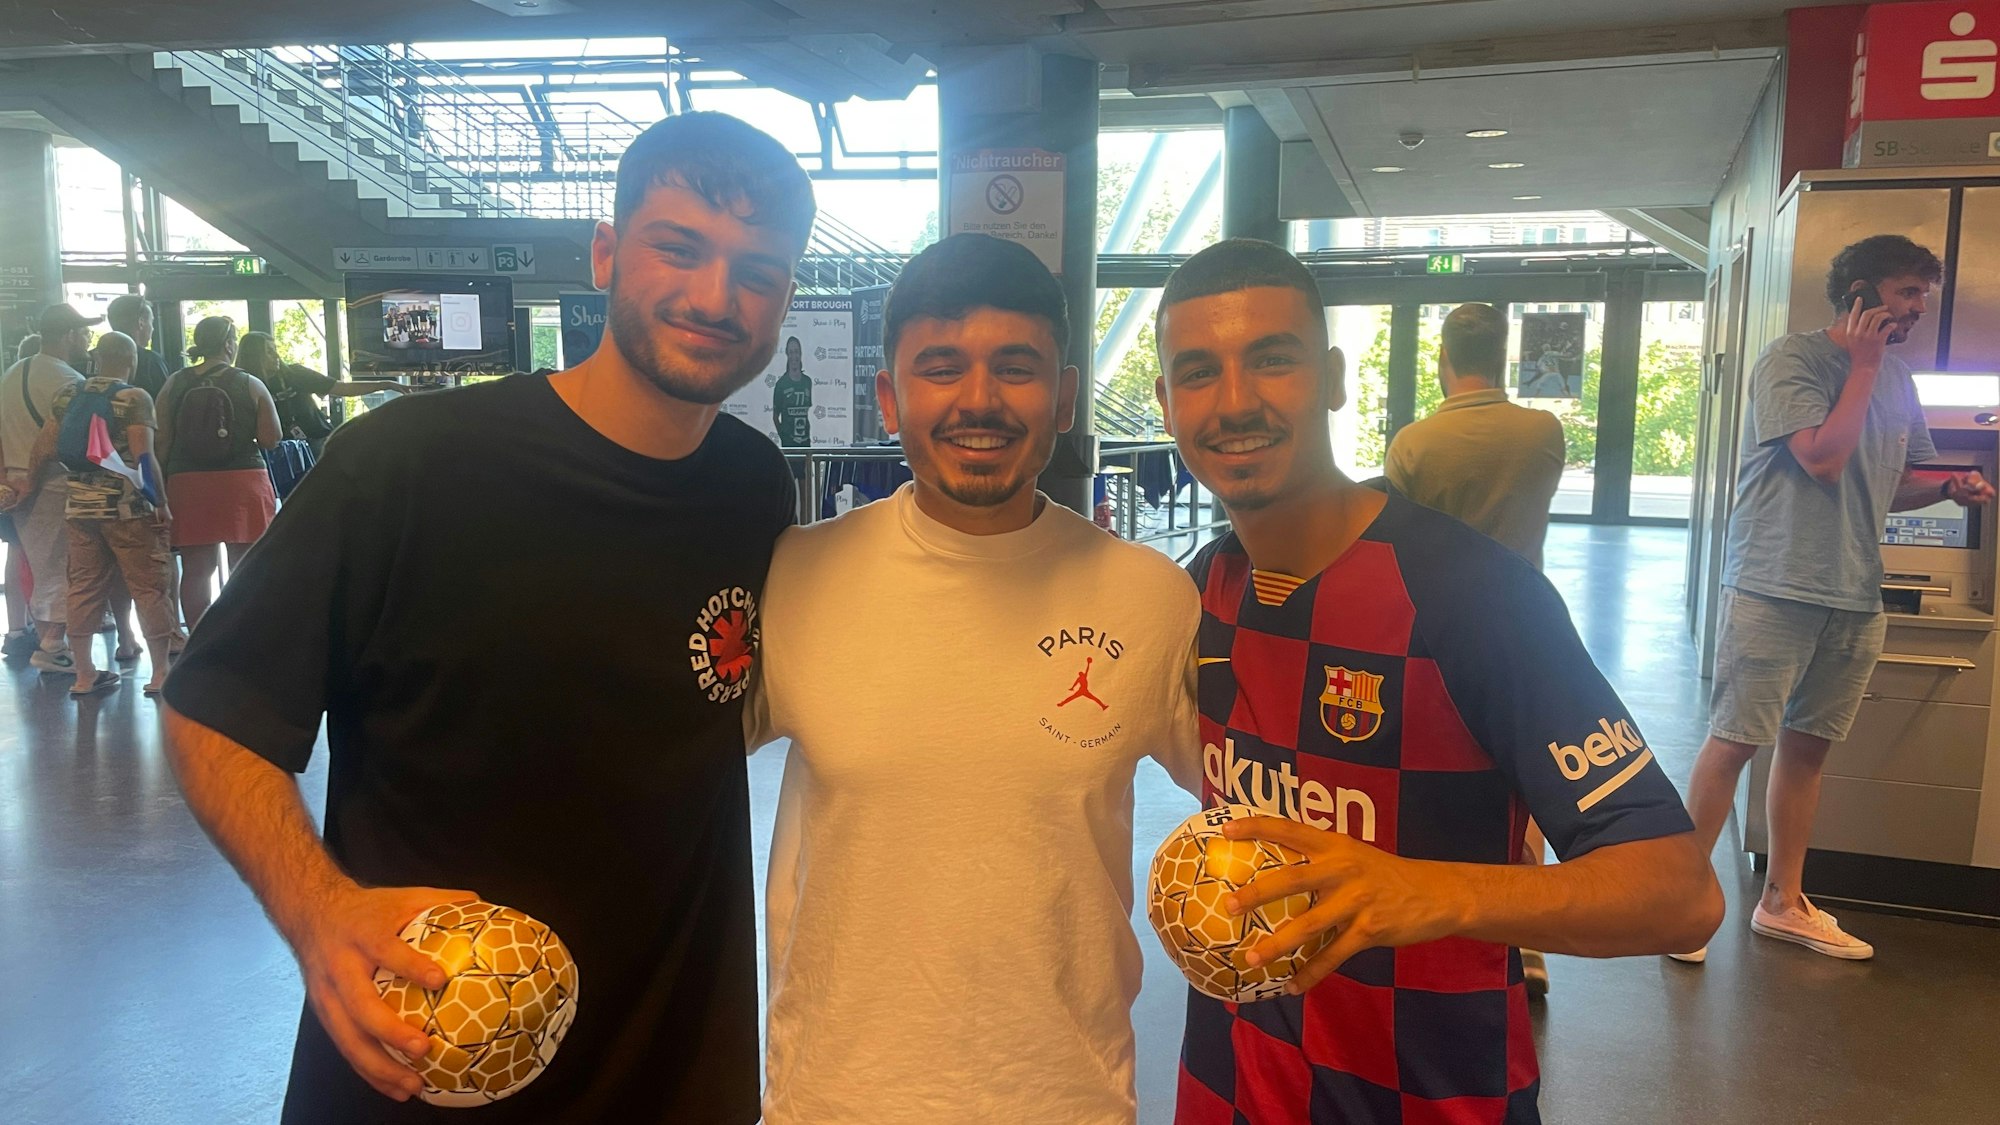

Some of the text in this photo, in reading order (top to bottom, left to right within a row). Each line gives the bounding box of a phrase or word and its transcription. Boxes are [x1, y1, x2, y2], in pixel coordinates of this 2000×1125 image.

[955, 153, 1060, 169] Nichtraucher
[963, 221, 1046, 231] Bitte nutzen Sie den
[498, 256, 514, 268] P3
[792, 301, 809, 309] ORT
[696, 587, 730, 633] HOT
[1037, 626, 1125, 660] PARIS
[689, 632, 718, 691] RED
[1547, 717, 1644, 781] beko
[1203, 737, 1376, 842] akuten
